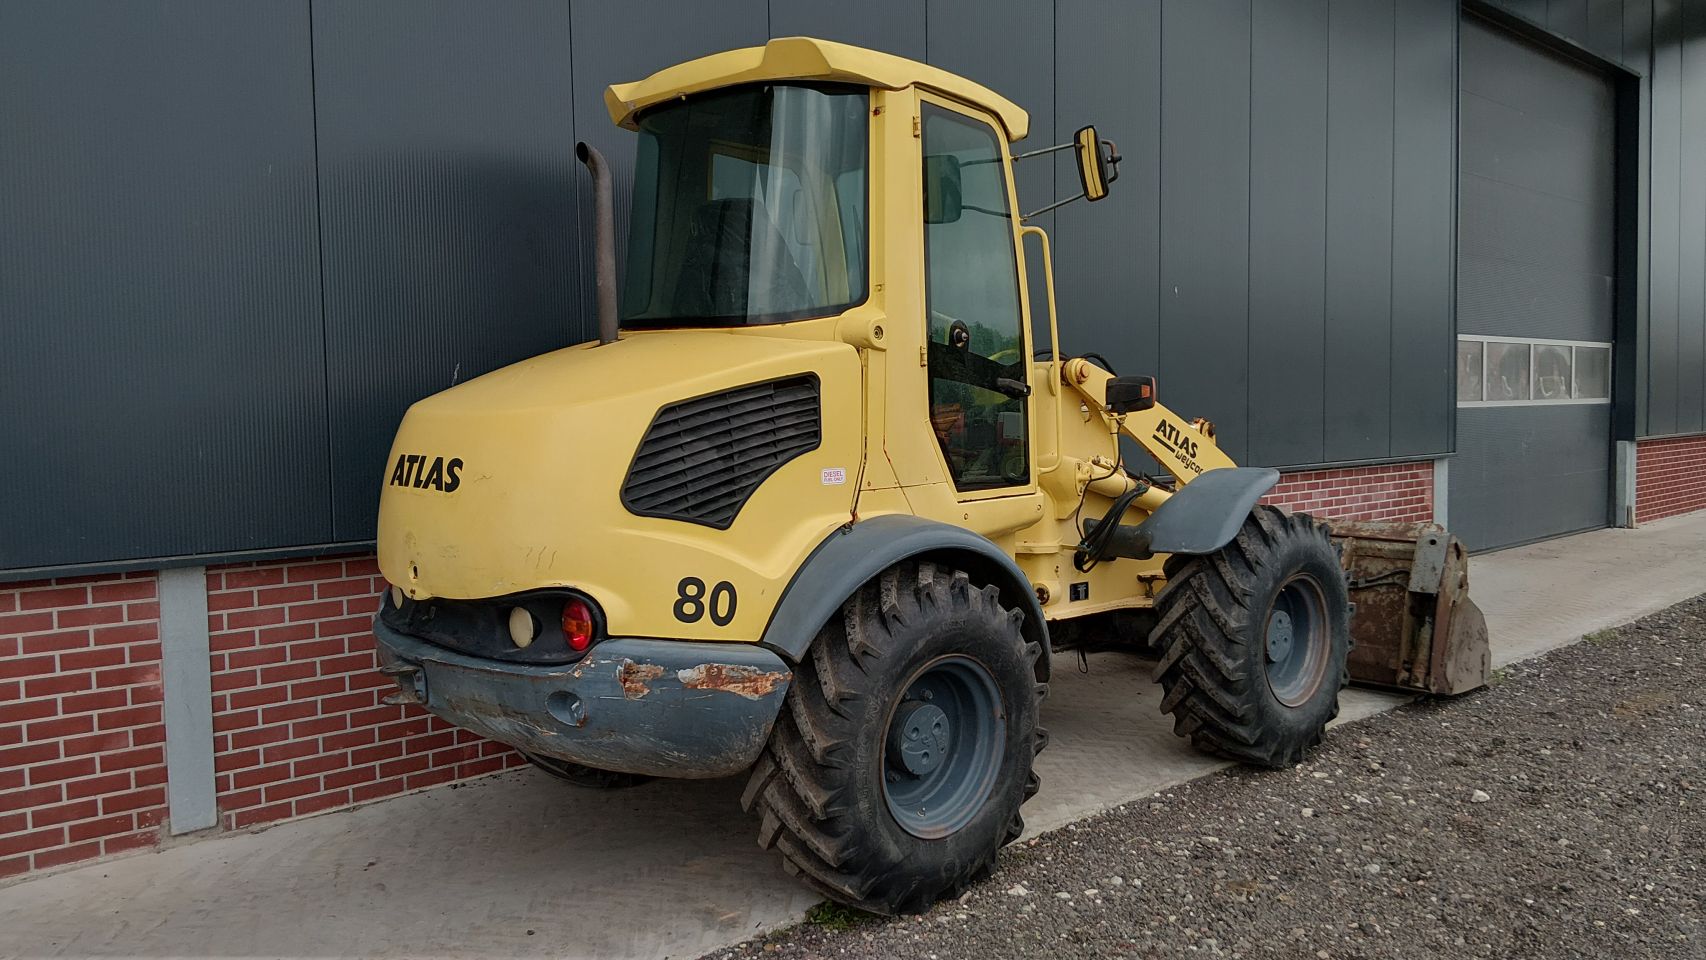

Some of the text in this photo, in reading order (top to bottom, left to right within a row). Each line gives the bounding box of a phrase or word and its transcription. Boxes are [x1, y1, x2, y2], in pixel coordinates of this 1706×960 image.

[1156, 418, 1198, 459] ATLAS
[389, 454, 464, 493] ATLAS
[673, 576, 738, 627] 80
